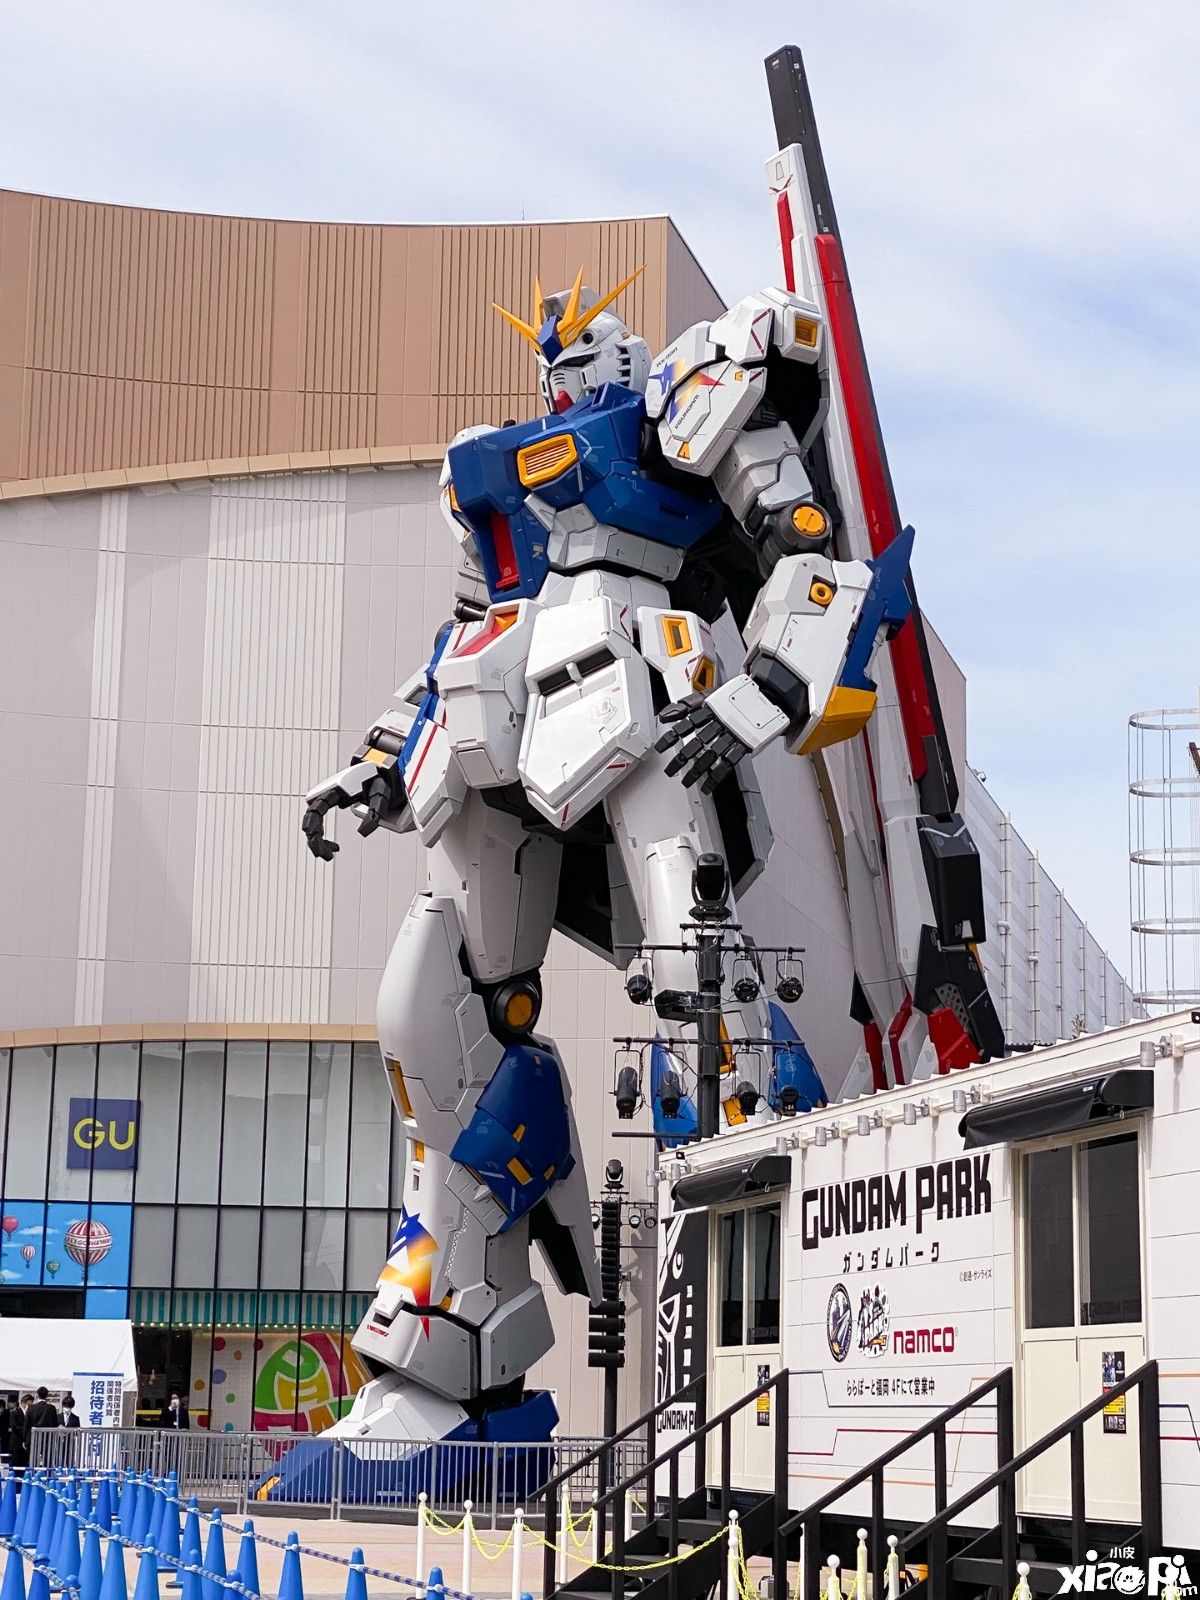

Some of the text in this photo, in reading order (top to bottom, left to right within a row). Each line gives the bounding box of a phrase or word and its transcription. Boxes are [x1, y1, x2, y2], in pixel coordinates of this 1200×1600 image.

[73, 1117, 135, 1151] GU
[802, 1153, 992, 1251] GUNDAM PARK
[843, 1242, 940, 1274] ガンダムパーク
[893, 1326, 955, 1354] namco
